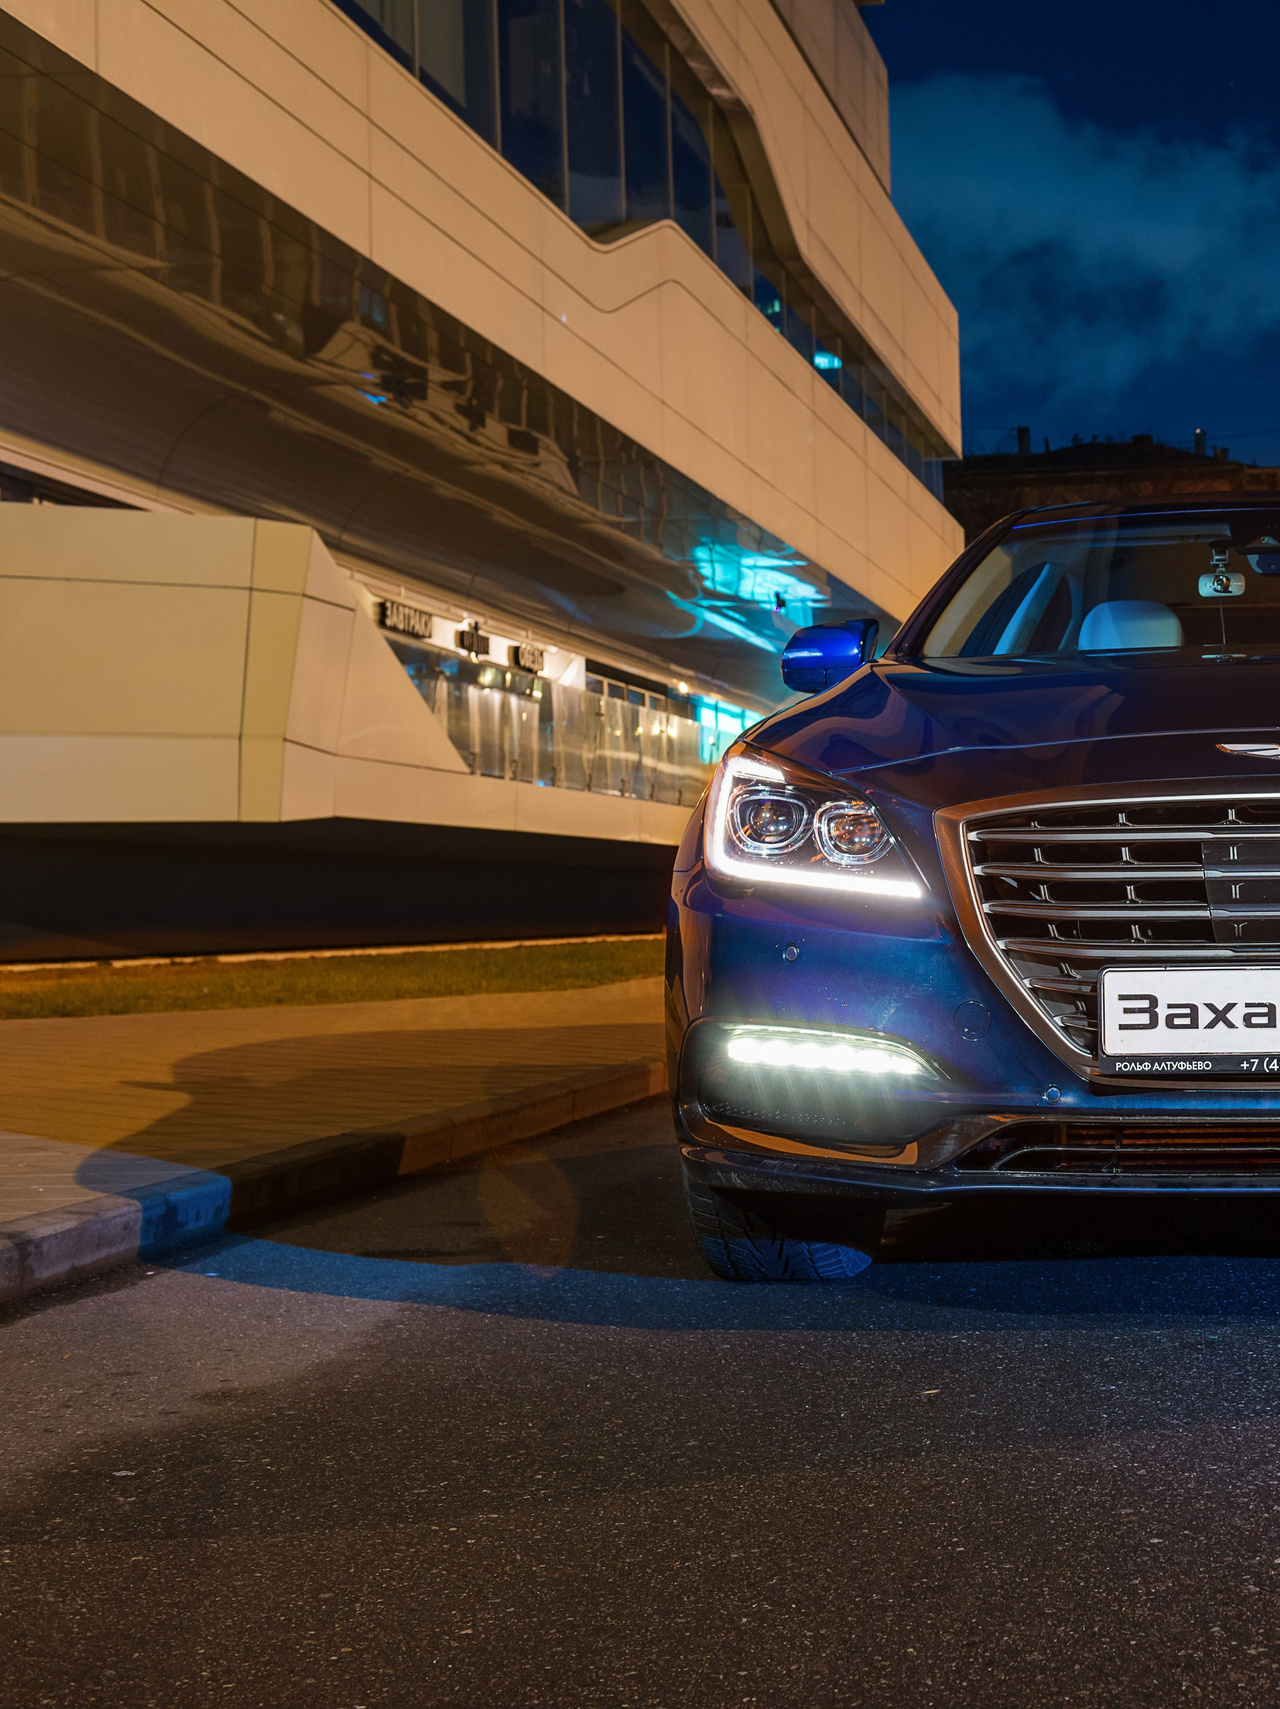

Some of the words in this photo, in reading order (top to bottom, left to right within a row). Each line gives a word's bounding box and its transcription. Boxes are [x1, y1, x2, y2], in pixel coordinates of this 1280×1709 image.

[384, 600, 433, 639] ЗАВТРАКИ
[1115, 1061, 1151, 1071] РОЛЬФ
[1152, 1060, 1212, 1071] АЛТУФЬЕВО
[1240, 1058, 1259, 1072] +7
